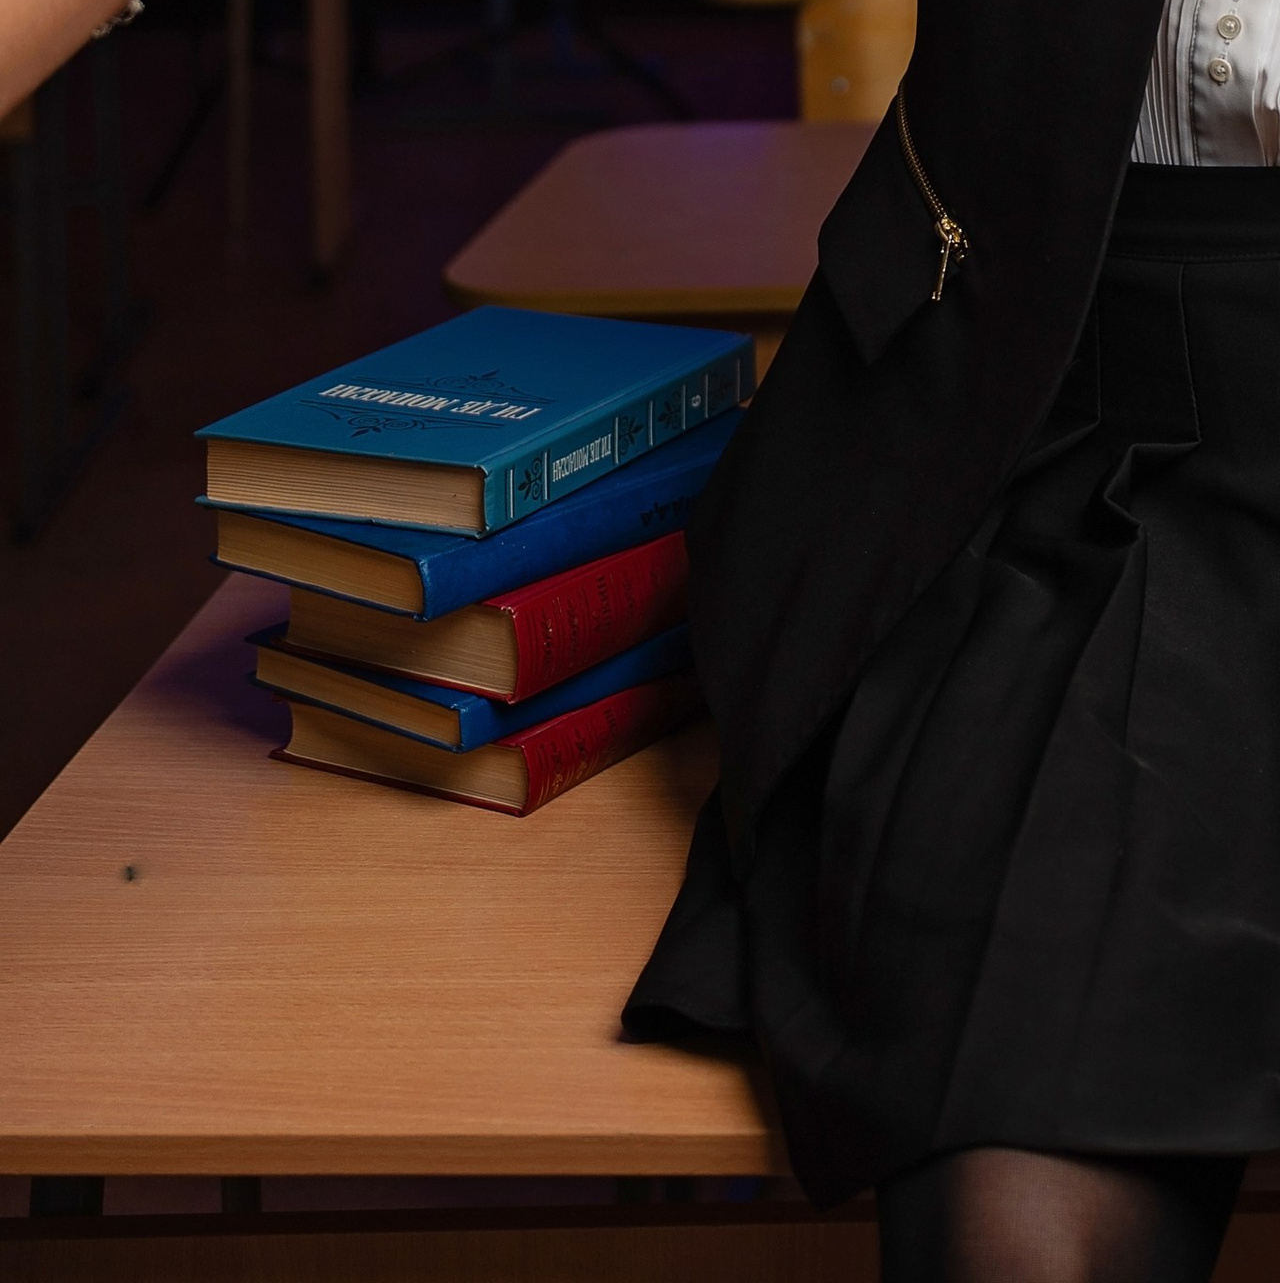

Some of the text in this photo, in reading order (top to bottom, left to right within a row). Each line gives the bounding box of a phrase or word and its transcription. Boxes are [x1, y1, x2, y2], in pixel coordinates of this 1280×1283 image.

[318, 384, 542, 420] ГИ ДЕ МОПАССАН
[552, 433, 612, 482] ГИ ДЕ МОПАССАН
